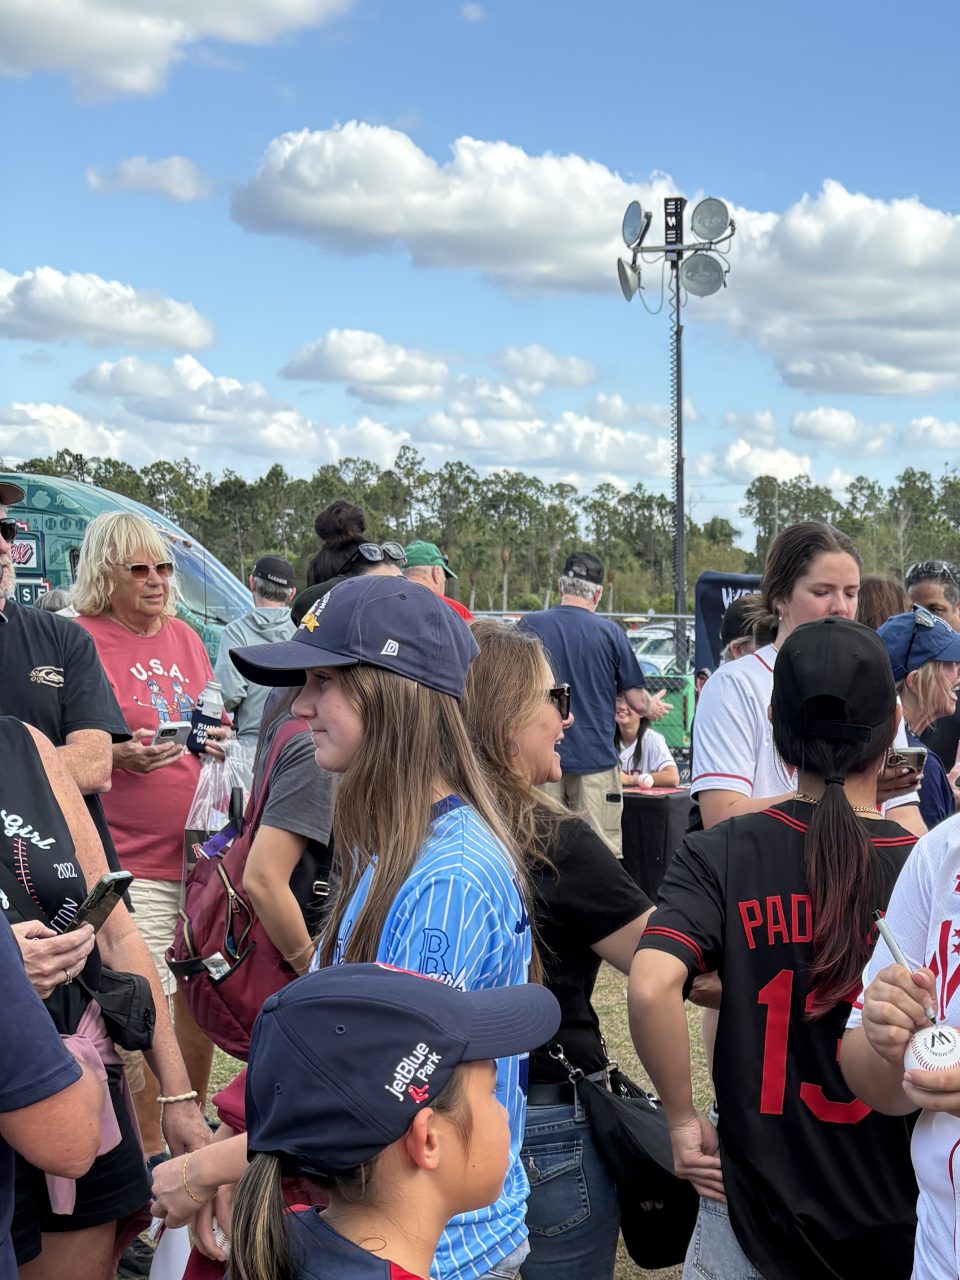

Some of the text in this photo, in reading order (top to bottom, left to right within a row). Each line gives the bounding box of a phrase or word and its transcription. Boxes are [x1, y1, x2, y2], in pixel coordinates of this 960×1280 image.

[130, 659, 189, 683] U.S.A.
[0, 810, 56, 849] Girl
[53, 862, 78, 879] 2022
[384, 1042, 430, 1102] jetBlue
[415, 1051, 442, 1082] Park
